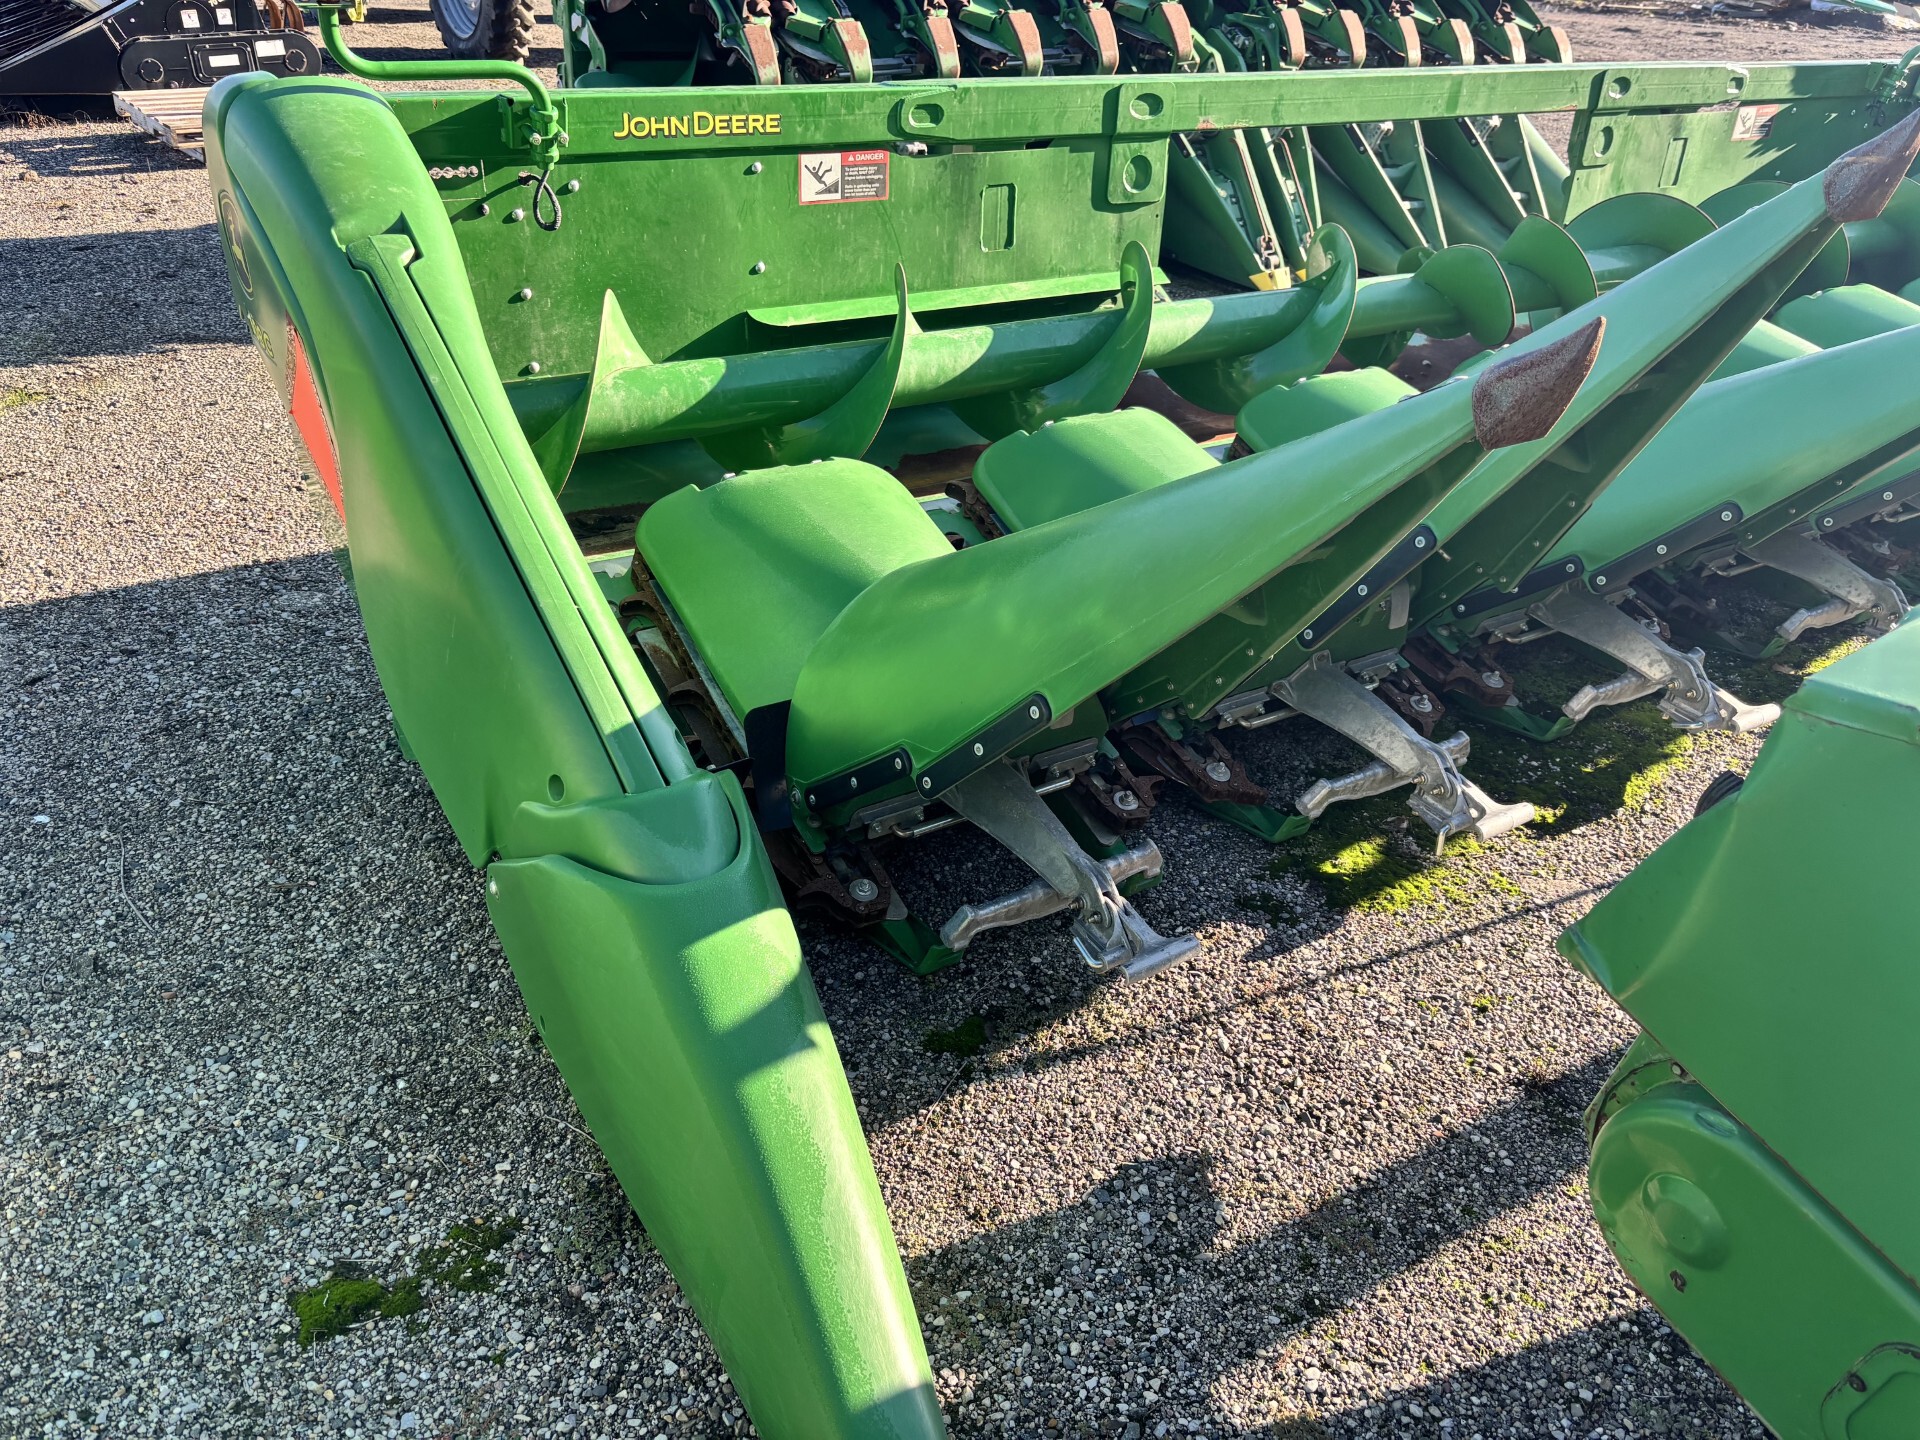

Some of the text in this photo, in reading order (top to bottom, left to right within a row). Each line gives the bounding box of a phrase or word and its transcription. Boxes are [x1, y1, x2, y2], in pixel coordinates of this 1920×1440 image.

[614, 111, 782, 139] JOHN DEERE
[855, 152, 884, 161] DANGER
